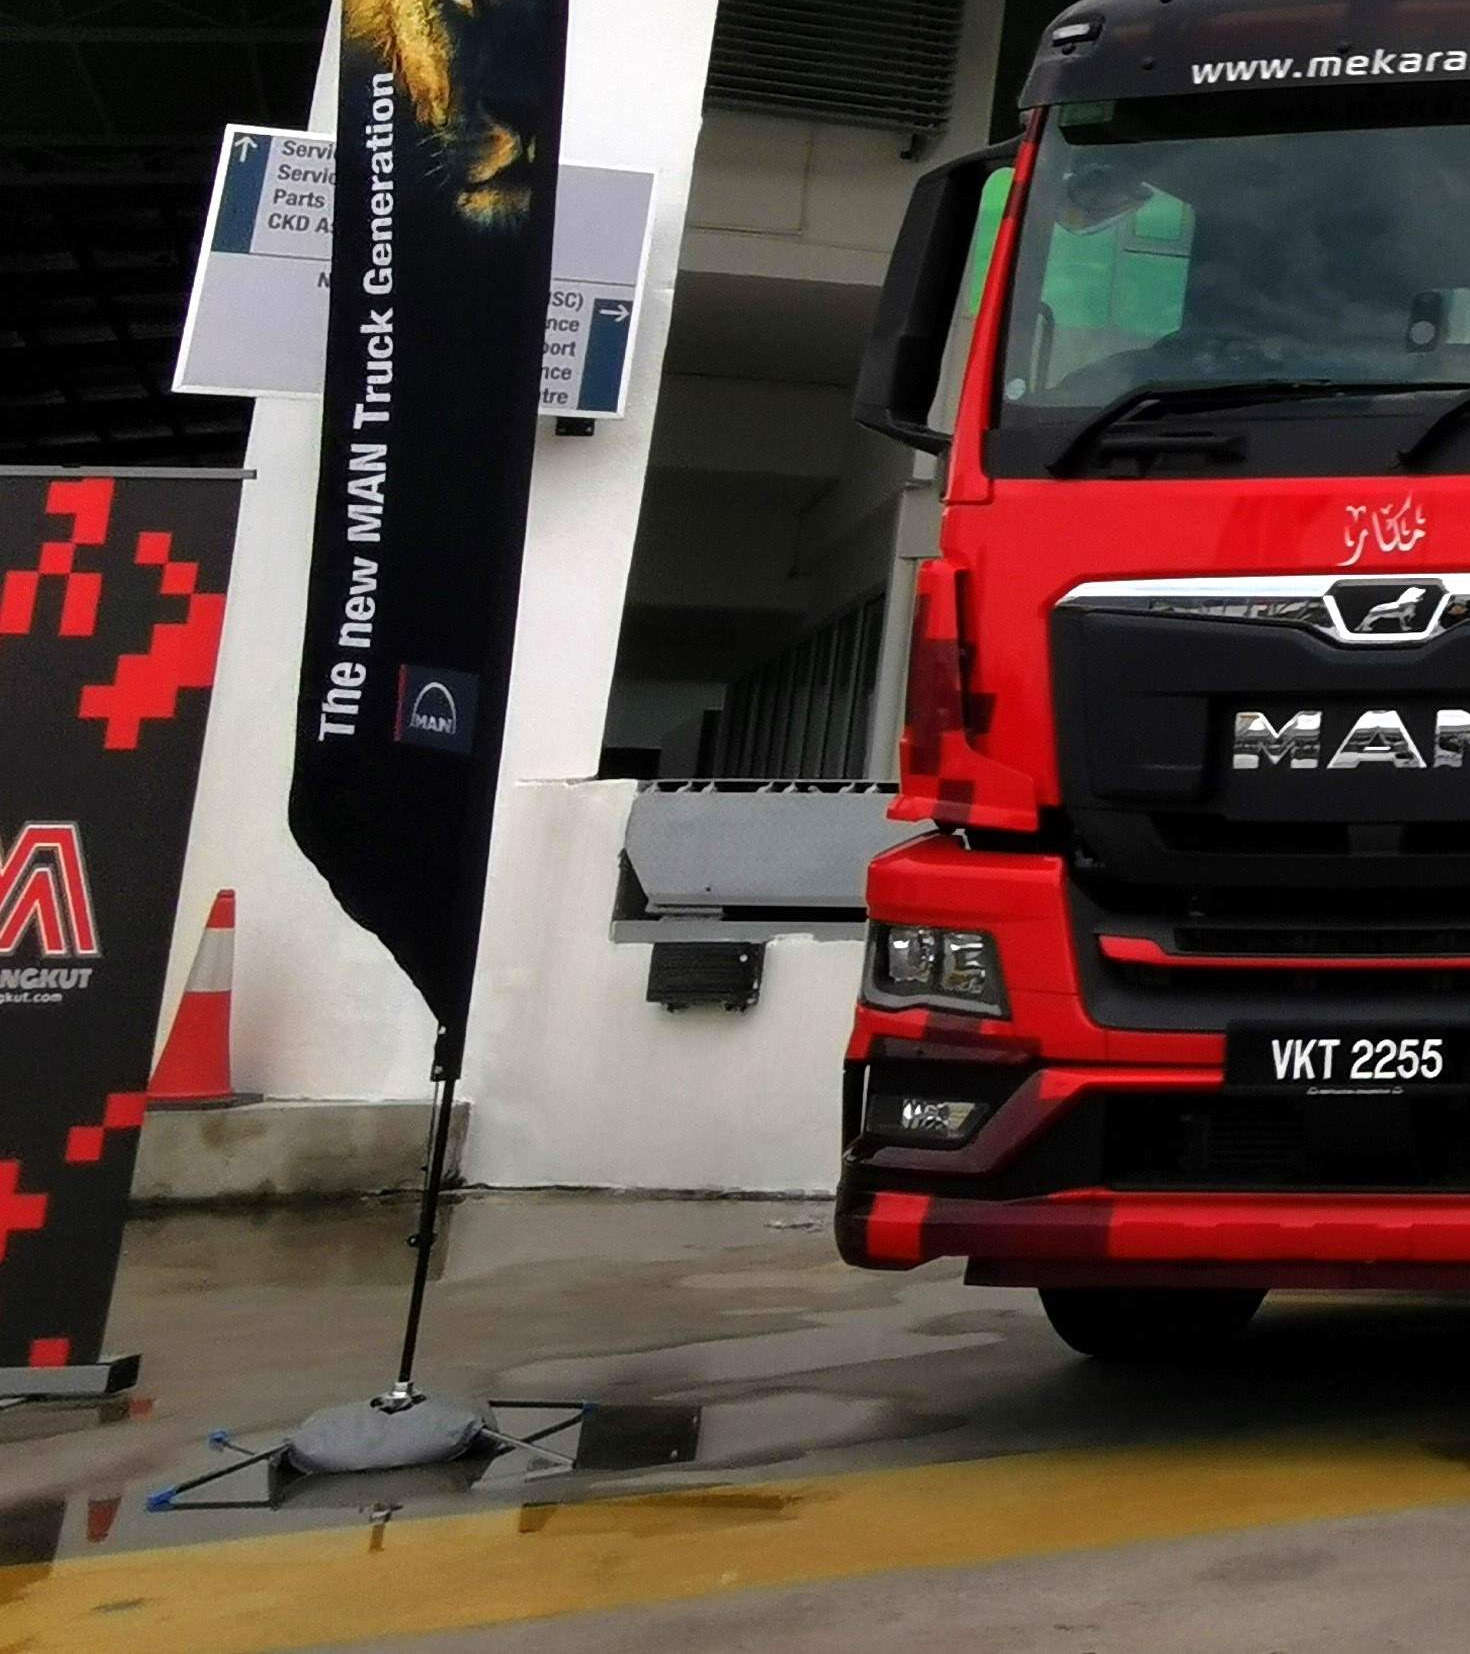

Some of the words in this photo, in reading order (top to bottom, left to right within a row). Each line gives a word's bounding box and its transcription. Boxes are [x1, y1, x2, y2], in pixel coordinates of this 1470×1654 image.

[281, 140, 336, 160] Servi
[273, 188, 326, 208] Parts
[361, 71, 396, 296] Generation
[268, 213, 310, 232] CKD
[352, 307, 394, 427] Truck
[347, 444, 389, 545] MAN
[339, 557, 379, 649] new
[318, 660, 367, 743] The
[411, 713, 456, 735] MAN
[1271, 1039, 1341, 1082] VKT
[1350, 1038, 1444, 1080] 2255
